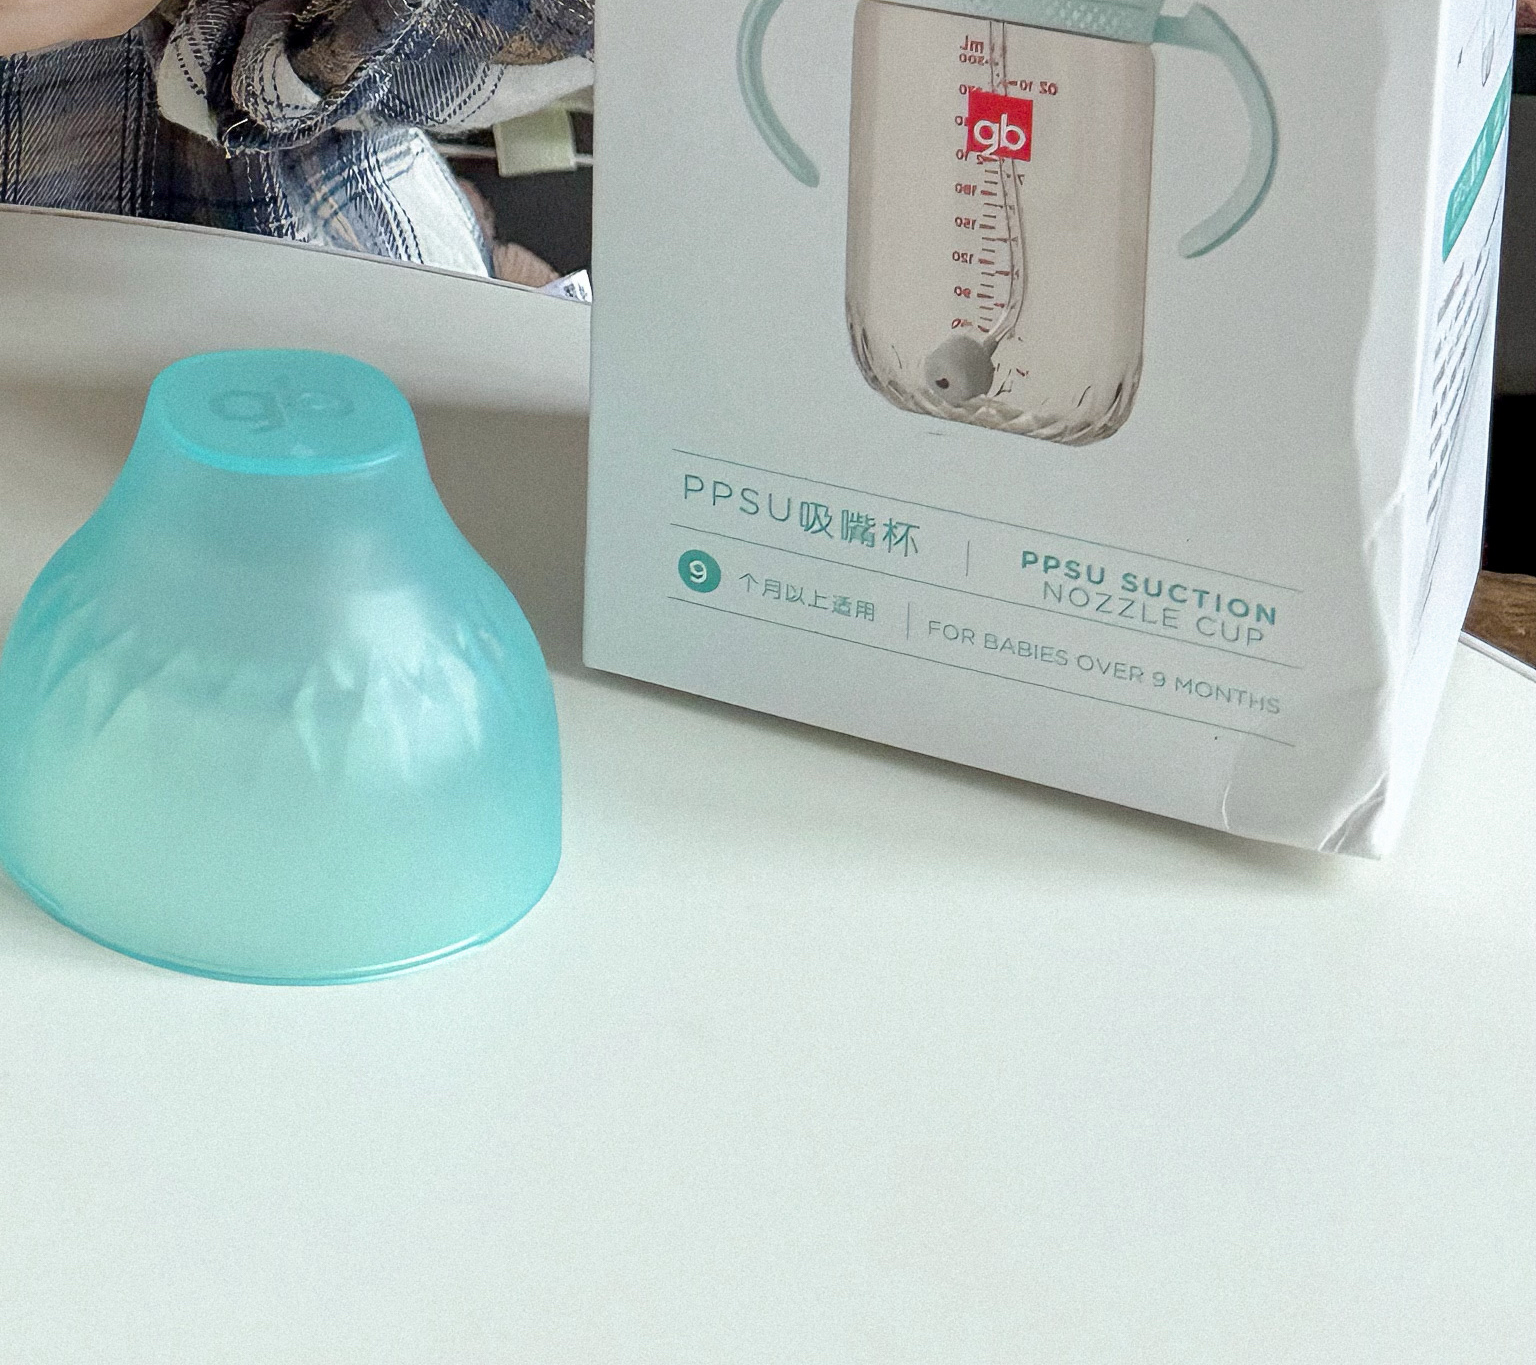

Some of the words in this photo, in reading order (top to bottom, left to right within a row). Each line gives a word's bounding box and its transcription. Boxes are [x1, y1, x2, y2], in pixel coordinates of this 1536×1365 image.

[973, 112, 1027, 156] gb
[683, 473, 921, 558] PPSU吸嘴杯
[688, 559, 708, 584] 9
[738, 572, 876, 622] 个月以上适用
[1021, 549, 1106, 586] PPSU
[1120, 571, 1277, 626] SUCTION
[1042, 580, 1180, 630] NOZZLE
[1195, 615, 1265, 647] CUP
[927, 619, 976, 646] FOR
[983, 632, 1069, 666] BABIES
[1076, 654, 1146, 684] OVER
[1152, 670, 1166, 688] 9
[1174, 675, 1281, 715] MONTHS
